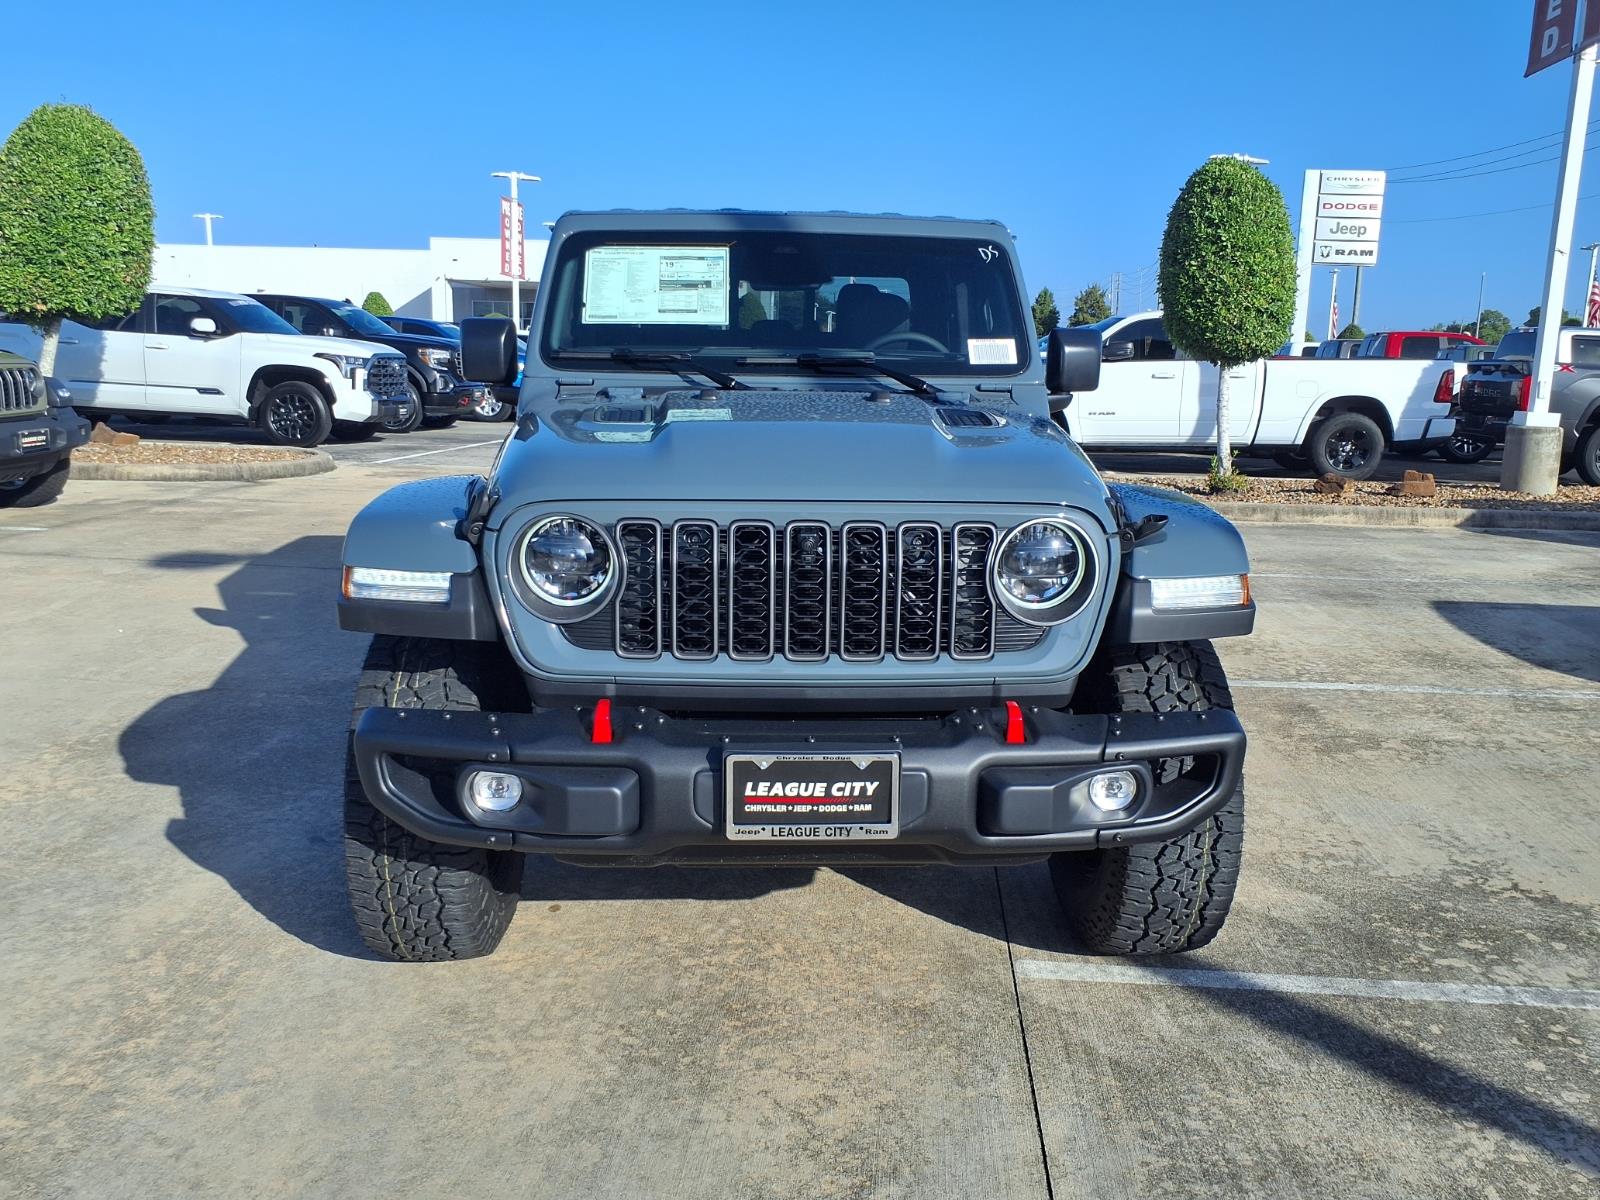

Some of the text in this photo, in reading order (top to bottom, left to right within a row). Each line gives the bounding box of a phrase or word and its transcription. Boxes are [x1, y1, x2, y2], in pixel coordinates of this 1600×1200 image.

[1322, 202, 1378, 211] DODGE
[1329, 221, 1367, 237] Jeep
[1334, 249, 1374, 257] RAM
[744, 781, 880, 797] LEAGUE CITY
[744, 803, 872, 812] CHRYSLER JEEP DODGE RAM
[771, 827, 820, 837] LEAGUE
[824, 827, 852, 837] CITY
